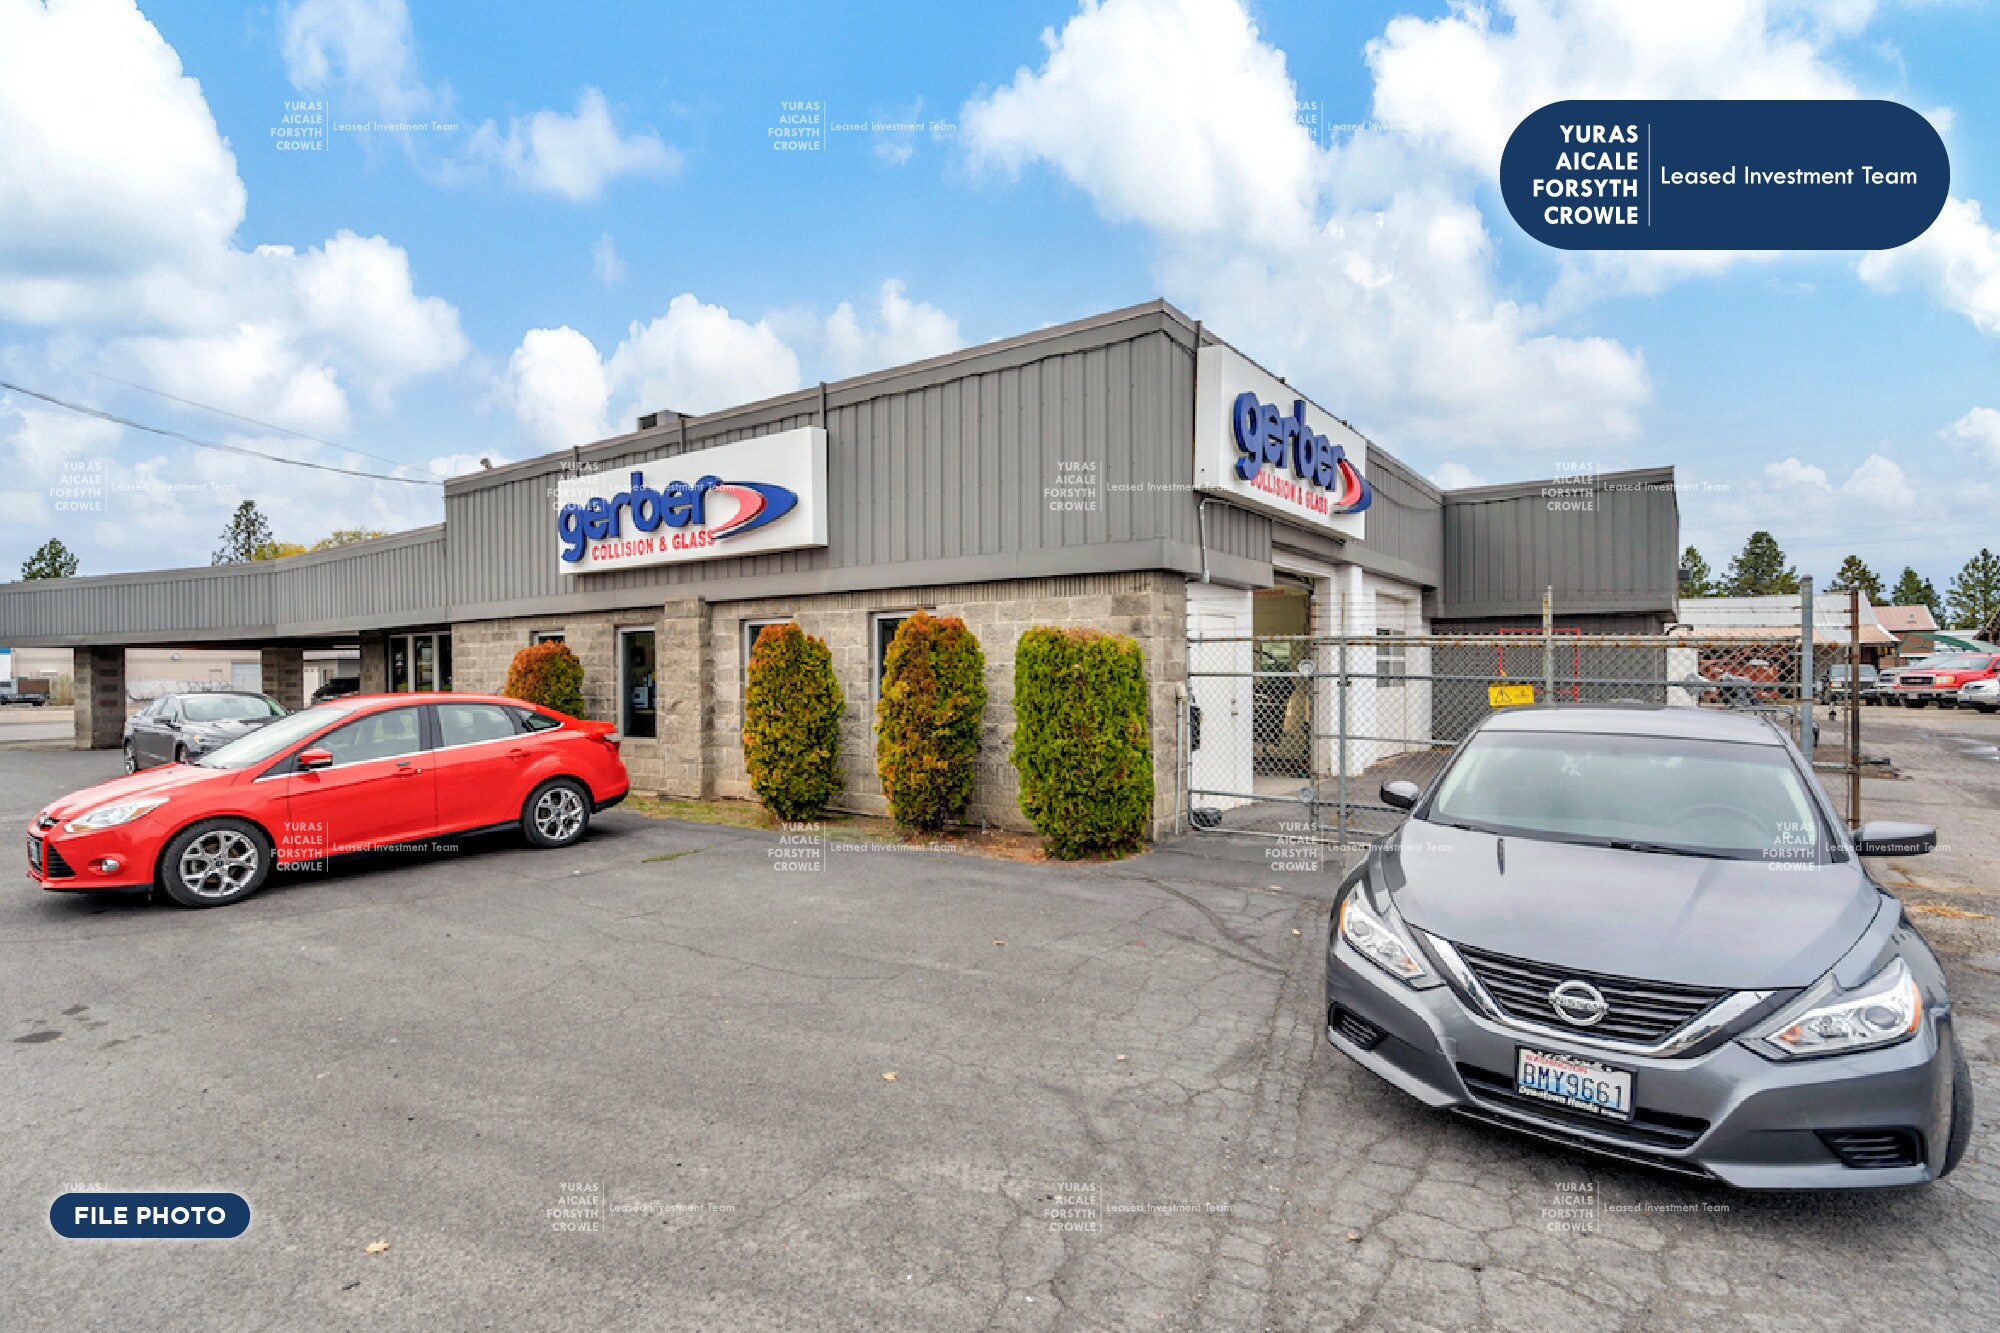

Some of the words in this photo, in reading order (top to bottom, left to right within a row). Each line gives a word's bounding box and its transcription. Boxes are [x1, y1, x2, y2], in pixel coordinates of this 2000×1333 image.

[1234, 391, 1345, 492] gerber
[558, 471, 722, 562] gerber
[592, 538, 654, 561] COLLISION
[659, 536, 667, 552] &
[672, 531, 716, 550] GLASS
[1524, 1062, 1622, 1108] BMY9661
